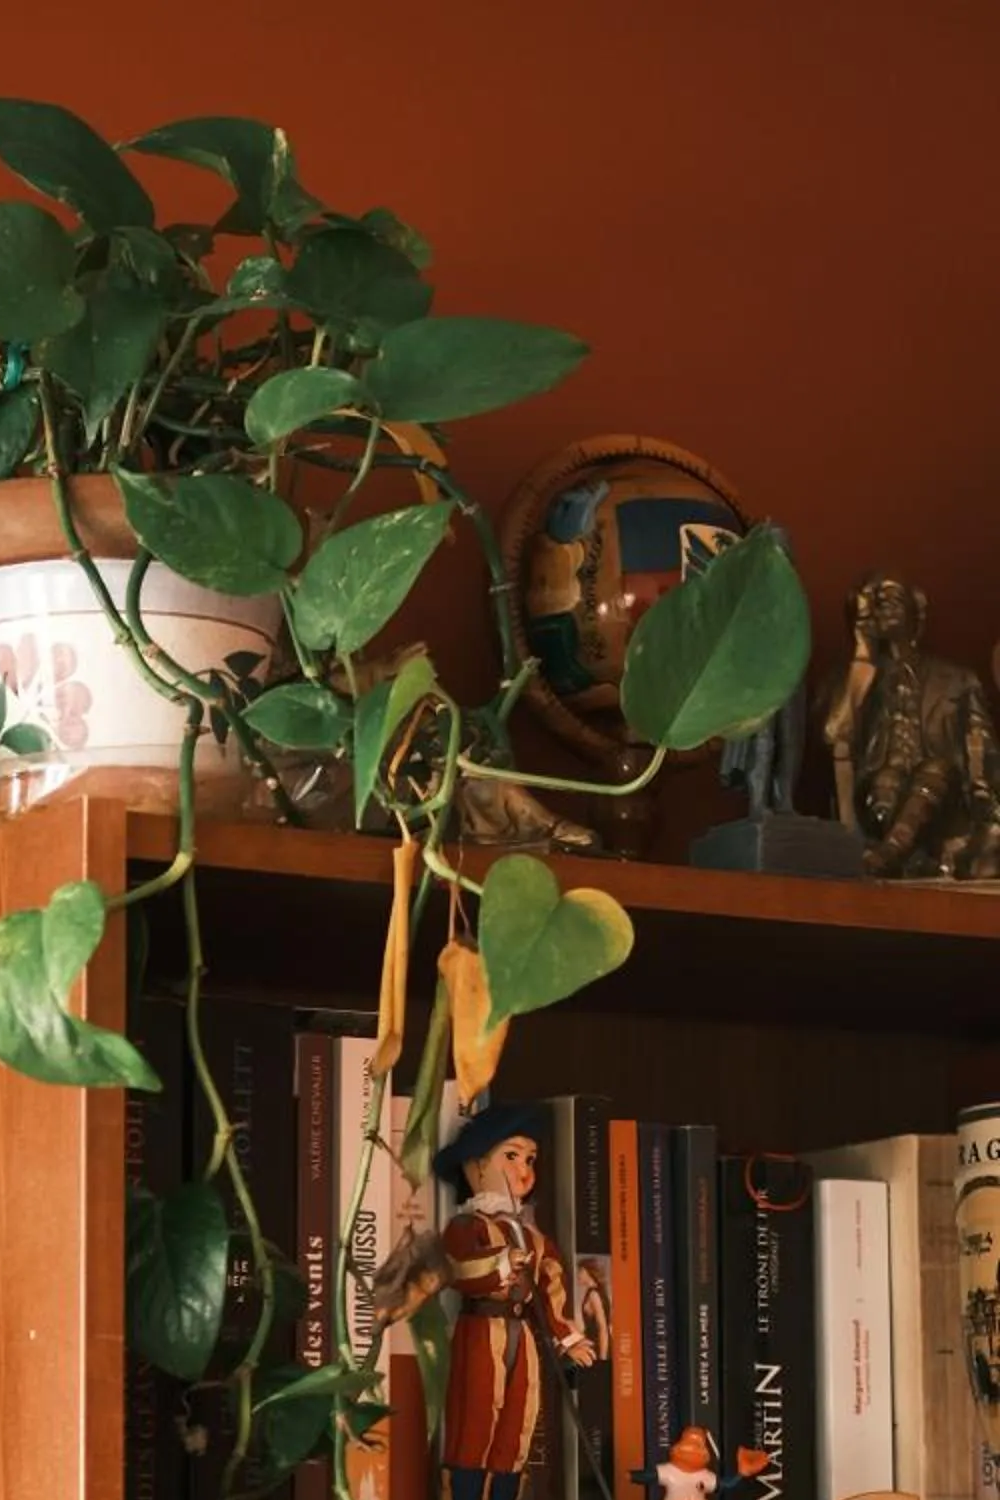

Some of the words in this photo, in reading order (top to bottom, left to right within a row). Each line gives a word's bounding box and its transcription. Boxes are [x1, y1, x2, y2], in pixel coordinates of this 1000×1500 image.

[354, 1211, 378, 1277] MUSSO
[756, 1226, 769, 1246] DE
[303, 1236, 324, 1309] vents
[653, 1278, 665, 1307] ROY
[654, 1313, 667, 1336] DU
[756, 1315, 770, 1333] LE
[302, 1321, 324, 1367] des
[655, 1344, 669, 1381] FILLE
